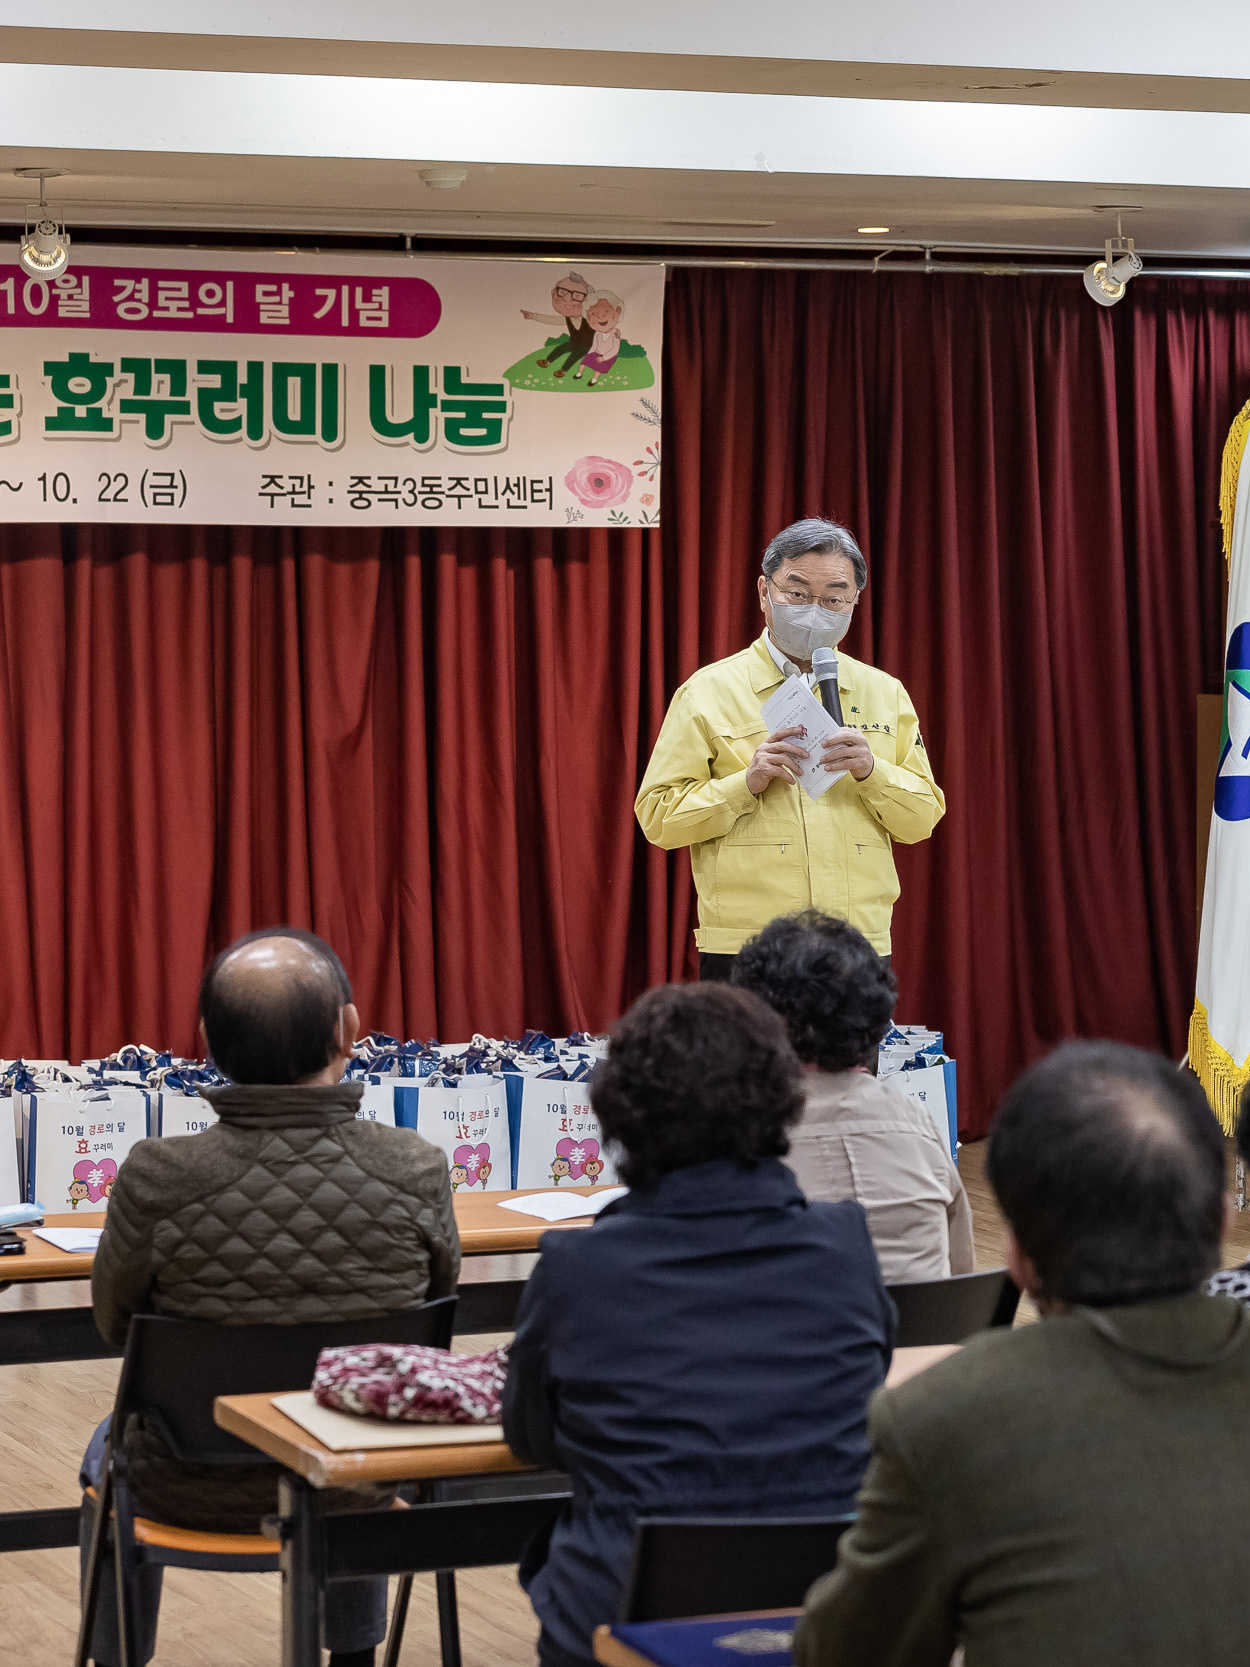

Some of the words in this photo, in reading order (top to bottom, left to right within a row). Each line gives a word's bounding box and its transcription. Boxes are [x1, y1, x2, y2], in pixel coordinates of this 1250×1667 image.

[0, 273, 91, 319] 10월
[112, 277, 234, 321] 경로의
[255, 282, 295, 325] 달
[313, 284, 390, 328] 기념
[43, 352, 339, 443] 효꾸러미
[368, 364, 508, 447] 나눔
[37, 472, 78, 504] 10.
[97, 472, 129, 503] 22
[139, 469, 188, 509] (금)
[258, 473, 316, 509] 주관
[346, 474, 554, 511] 중곡3동주민센터
[918, 1090, 927, 1102] 달
[368, 1110, 377, 1120] 달
[493, 1107, 500, 1118] 달
[546, 1103, 567, 1114] 10월
[61, 1125, 84, 1137] 10월
[88, 1122, 114, 1136] 경로의
[117, 1121, 126, 1133] 달
[185, 1121, 208, 1132] 10월
[74, 1138, 91, 1154] 효
[92, 1142, 114, 1153] 꾸러미
[467, 1153, 481, 1171] 孝
[569, 1147, 586, 1165] 孝
[87, 1168, 104, 1188] 孝
